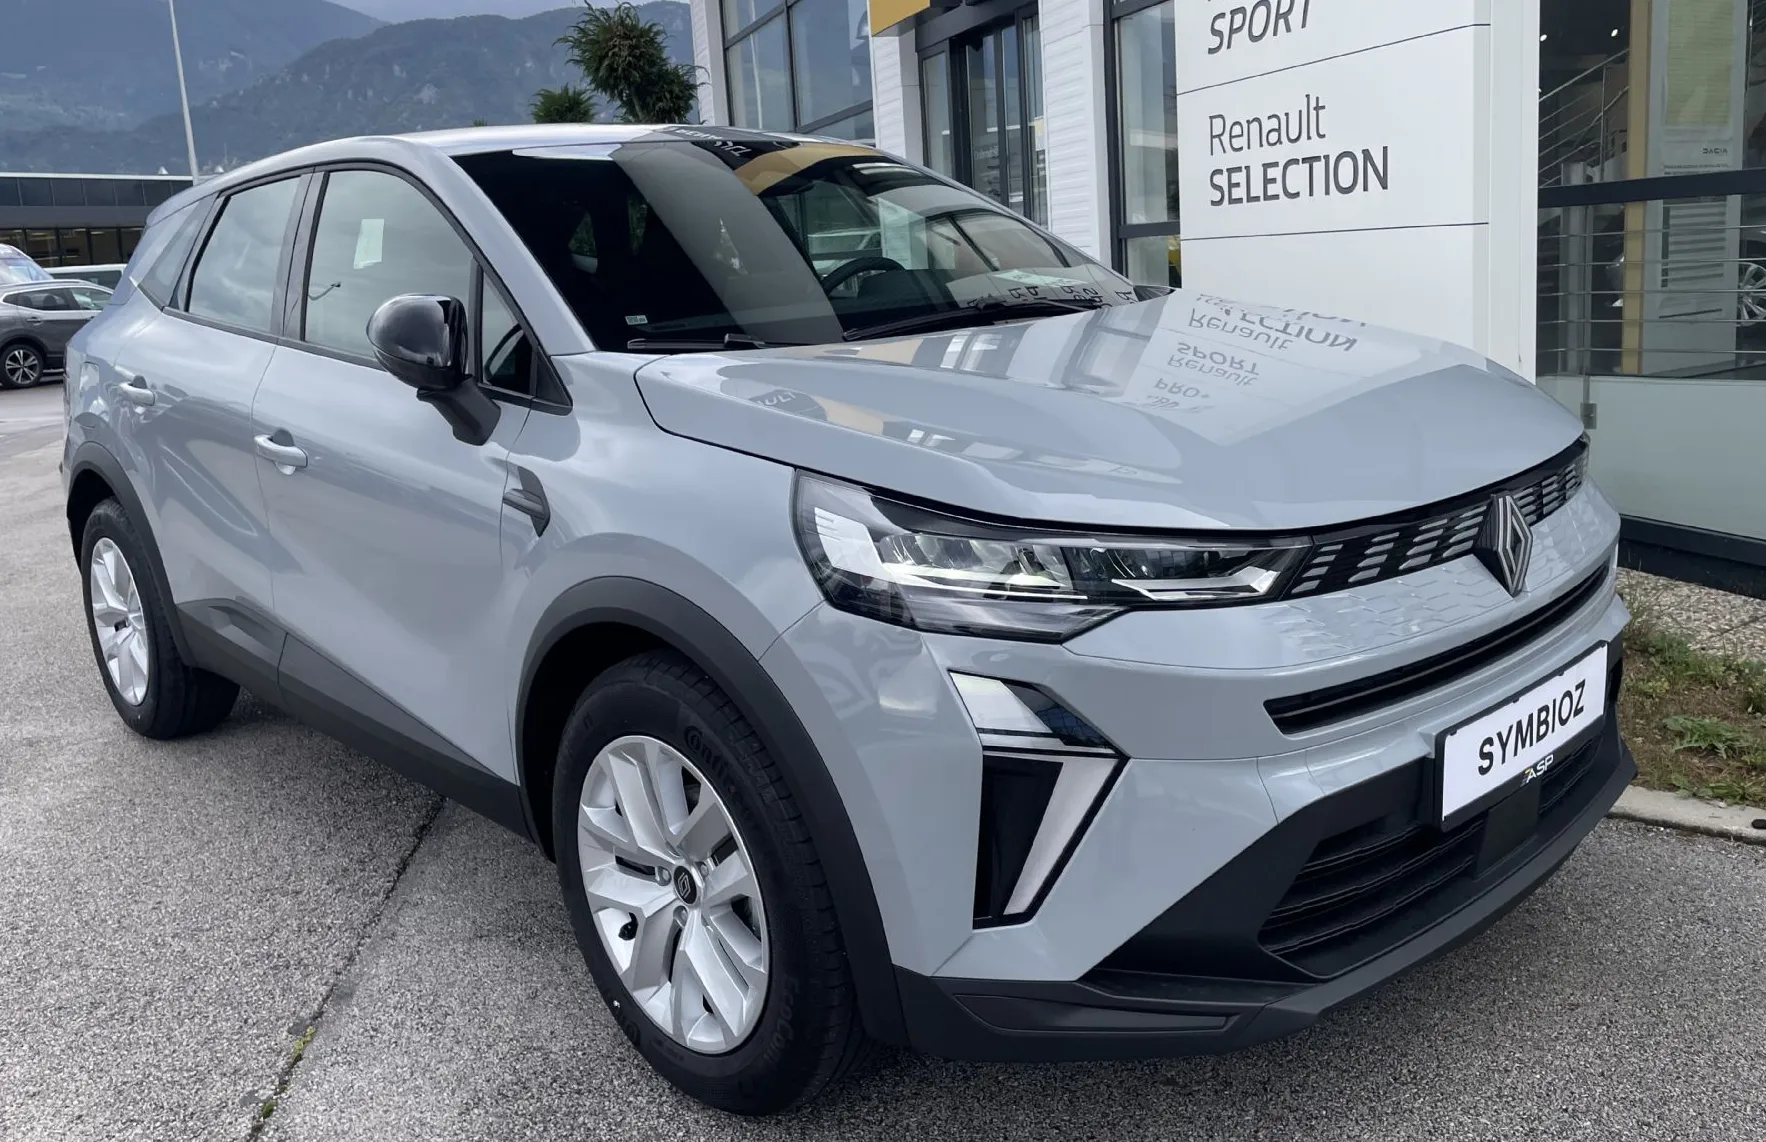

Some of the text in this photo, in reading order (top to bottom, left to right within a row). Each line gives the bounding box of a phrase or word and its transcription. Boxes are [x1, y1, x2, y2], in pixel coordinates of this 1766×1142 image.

[1208, 93, 1326, 156] Renault
[1209, 145, 1389, 207] SELECTION
[1477, 678, 1586, 776] SYMBIOZ
[1522, 754, 1554, 786] ASP
